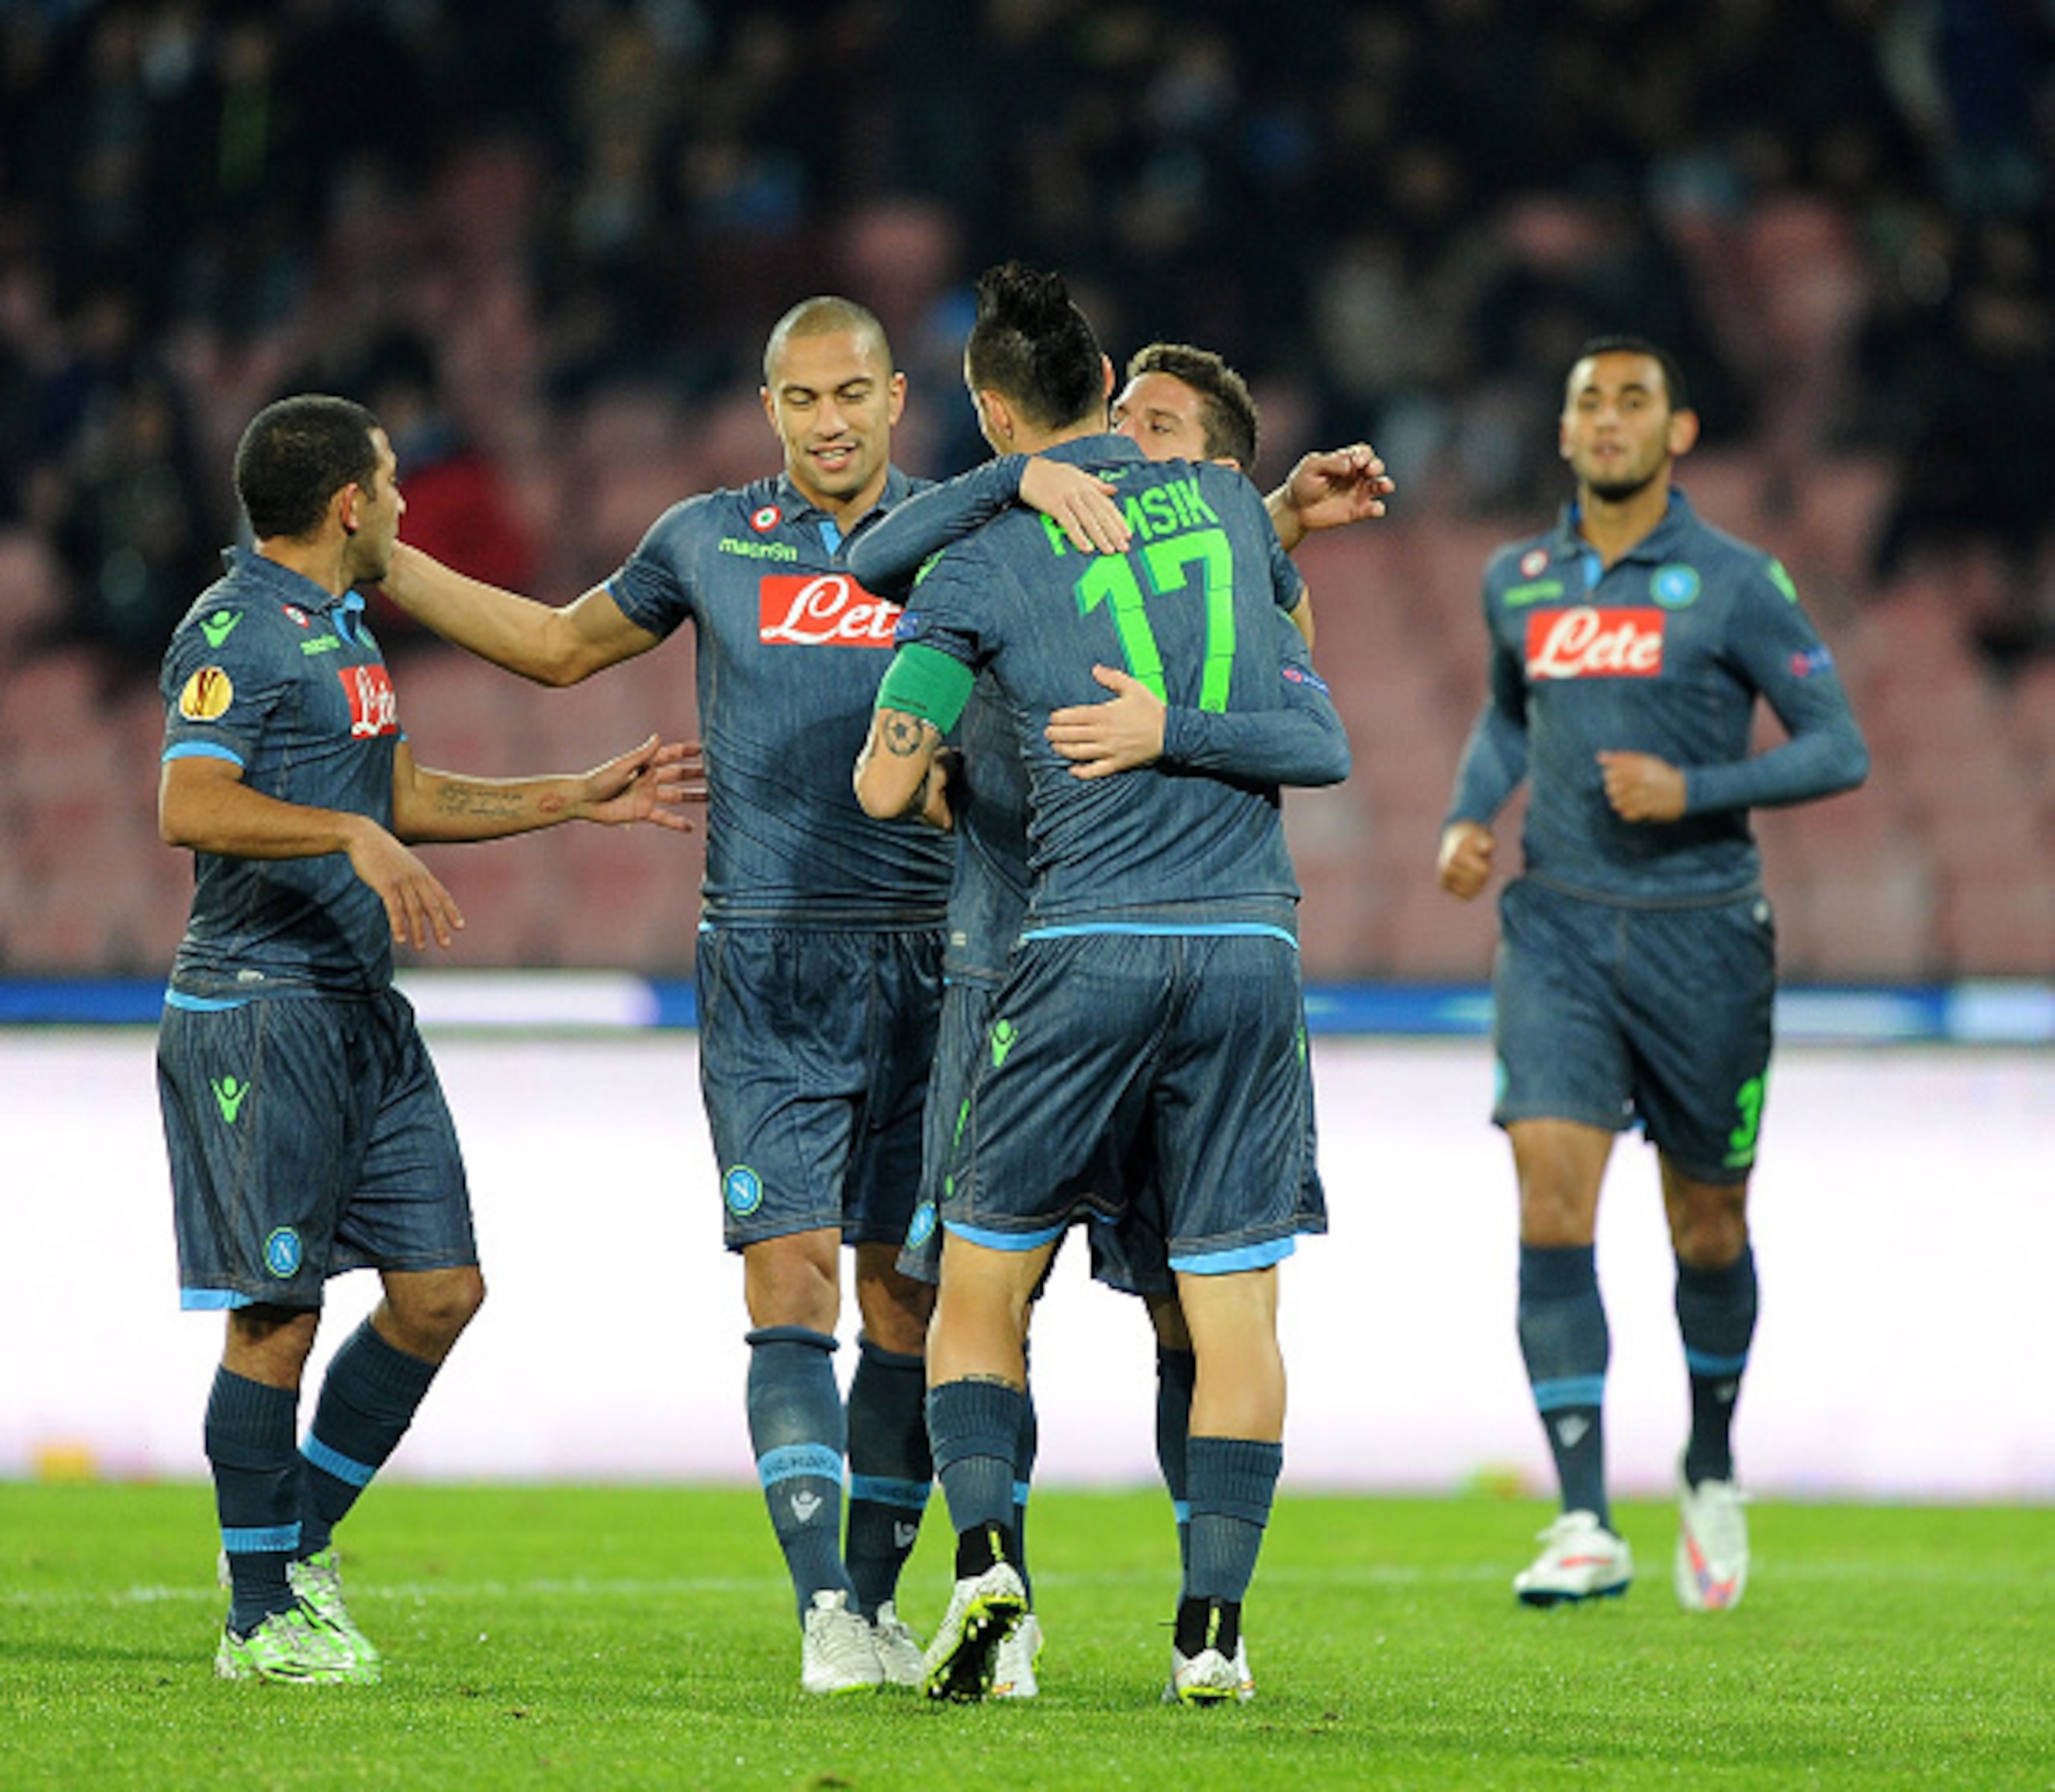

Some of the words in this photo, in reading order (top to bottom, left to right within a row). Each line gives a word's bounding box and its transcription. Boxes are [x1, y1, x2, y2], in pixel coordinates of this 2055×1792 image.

[760, 575, 901, 645] Let
[1073, 527, 1235, 715] 17
[1527, 606, 1664, 680] Lete
